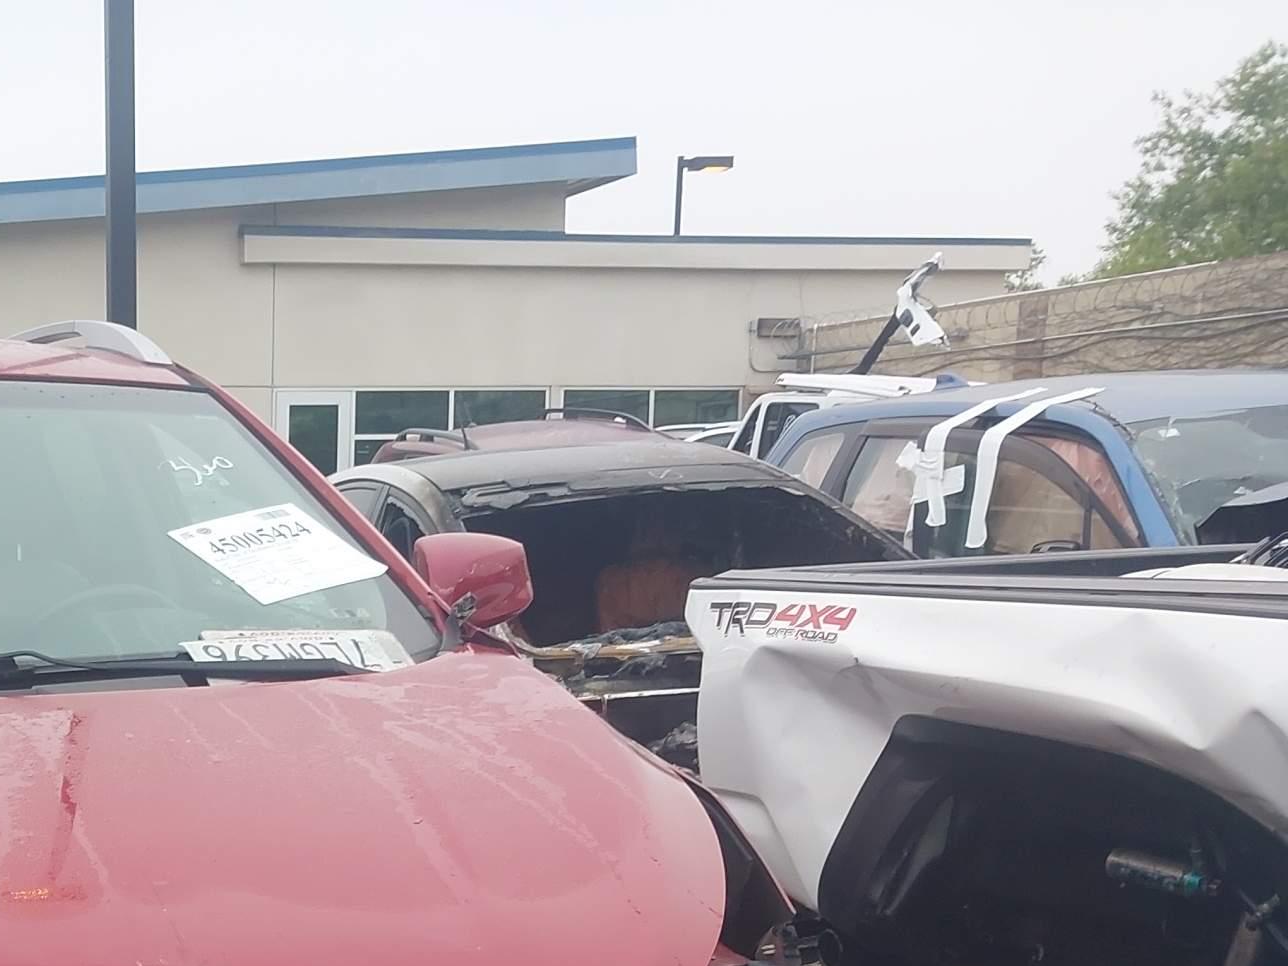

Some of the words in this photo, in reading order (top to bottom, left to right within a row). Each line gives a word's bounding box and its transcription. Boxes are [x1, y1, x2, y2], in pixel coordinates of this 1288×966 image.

[211, 521, 312, 555] 45005424
[710, 601, 777, 638] TRD
[765, 626, 795, 637] OFF
[795, 629, 839, 643] ROAD
